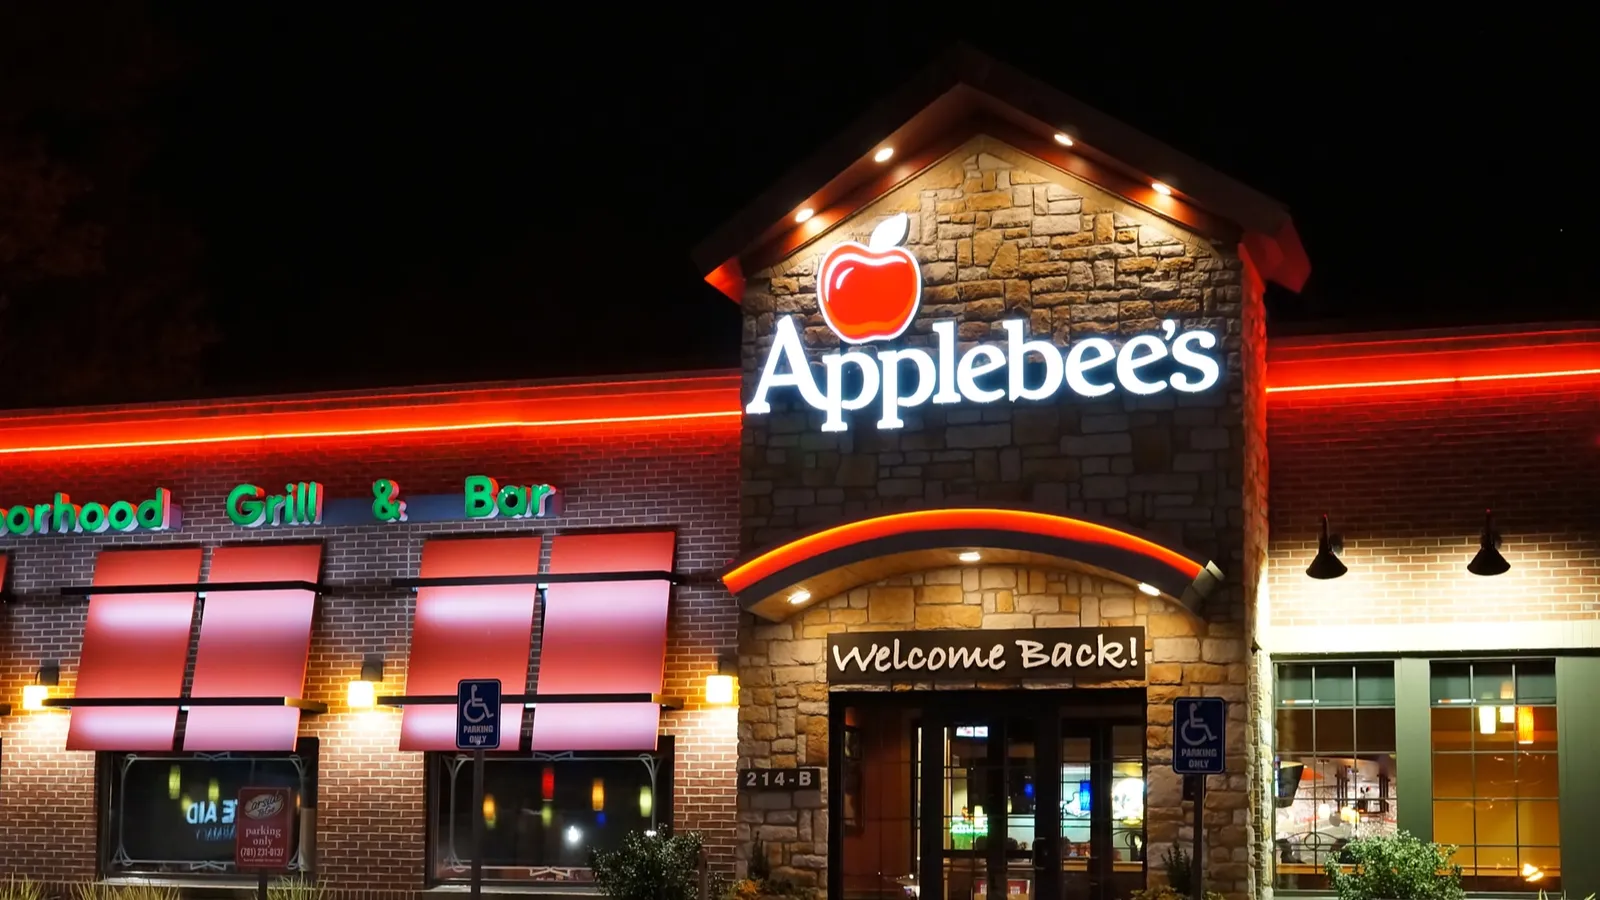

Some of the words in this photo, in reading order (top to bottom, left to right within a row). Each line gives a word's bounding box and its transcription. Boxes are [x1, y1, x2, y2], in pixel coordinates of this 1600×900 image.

[745, 313, 1221, 432] Applebee's
[0, 487, 169, 536] orhood
[226, 481, 322, 526] Grill
[372, 478, 406, 521] &
[465, 475, 555, 518] Bar
[832, 638, 1006, 673] Welcome
[1015, 634, 1138, 670] Back!
[463, 725, 494, 733] PARKING
[469, 735, 487, 744] ONLY
[1181, 748, 1218, 758] PARKING
[1188, 759, 1210, 768] ONLY
[746, 771, 812, 786] 214-B
[245, 825, 282, 838] parking
[252, 835, 273, 848] only
